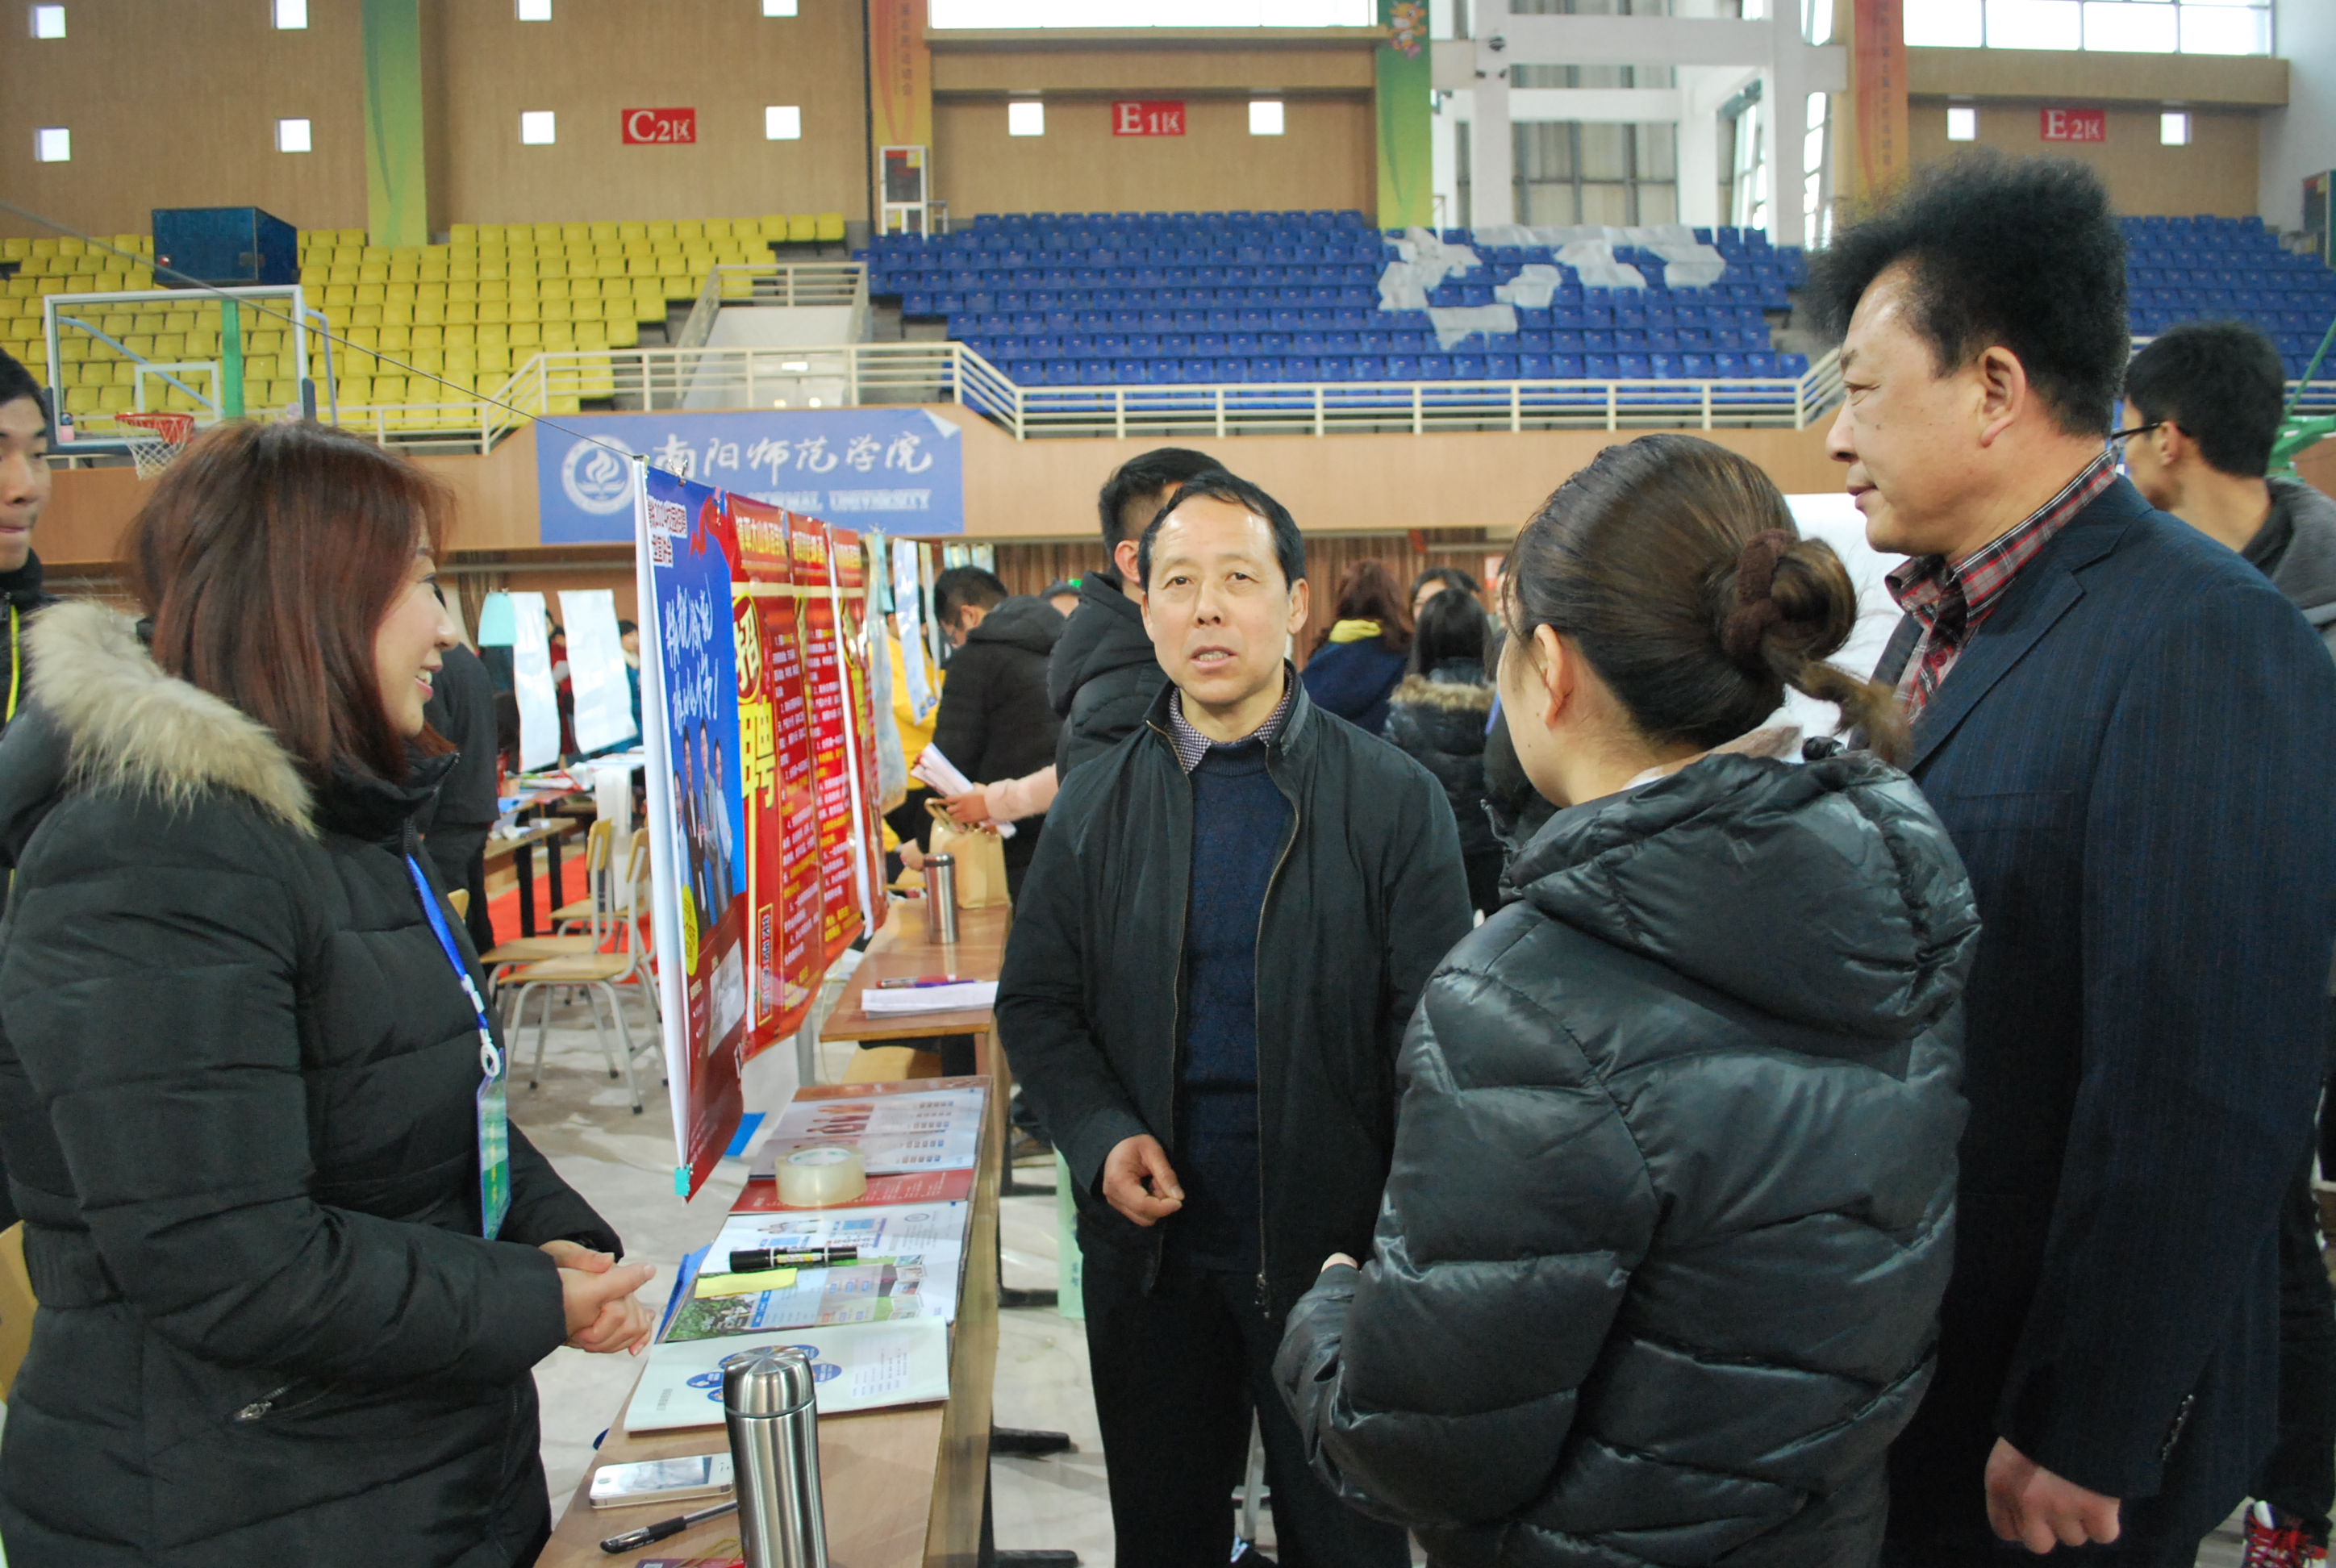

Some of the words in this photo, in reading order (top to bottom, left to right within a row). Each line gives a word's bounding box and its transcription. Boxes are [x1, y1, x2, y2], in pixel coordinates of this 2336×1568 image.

[653, 432, 933, 486] 南阳师范学院
